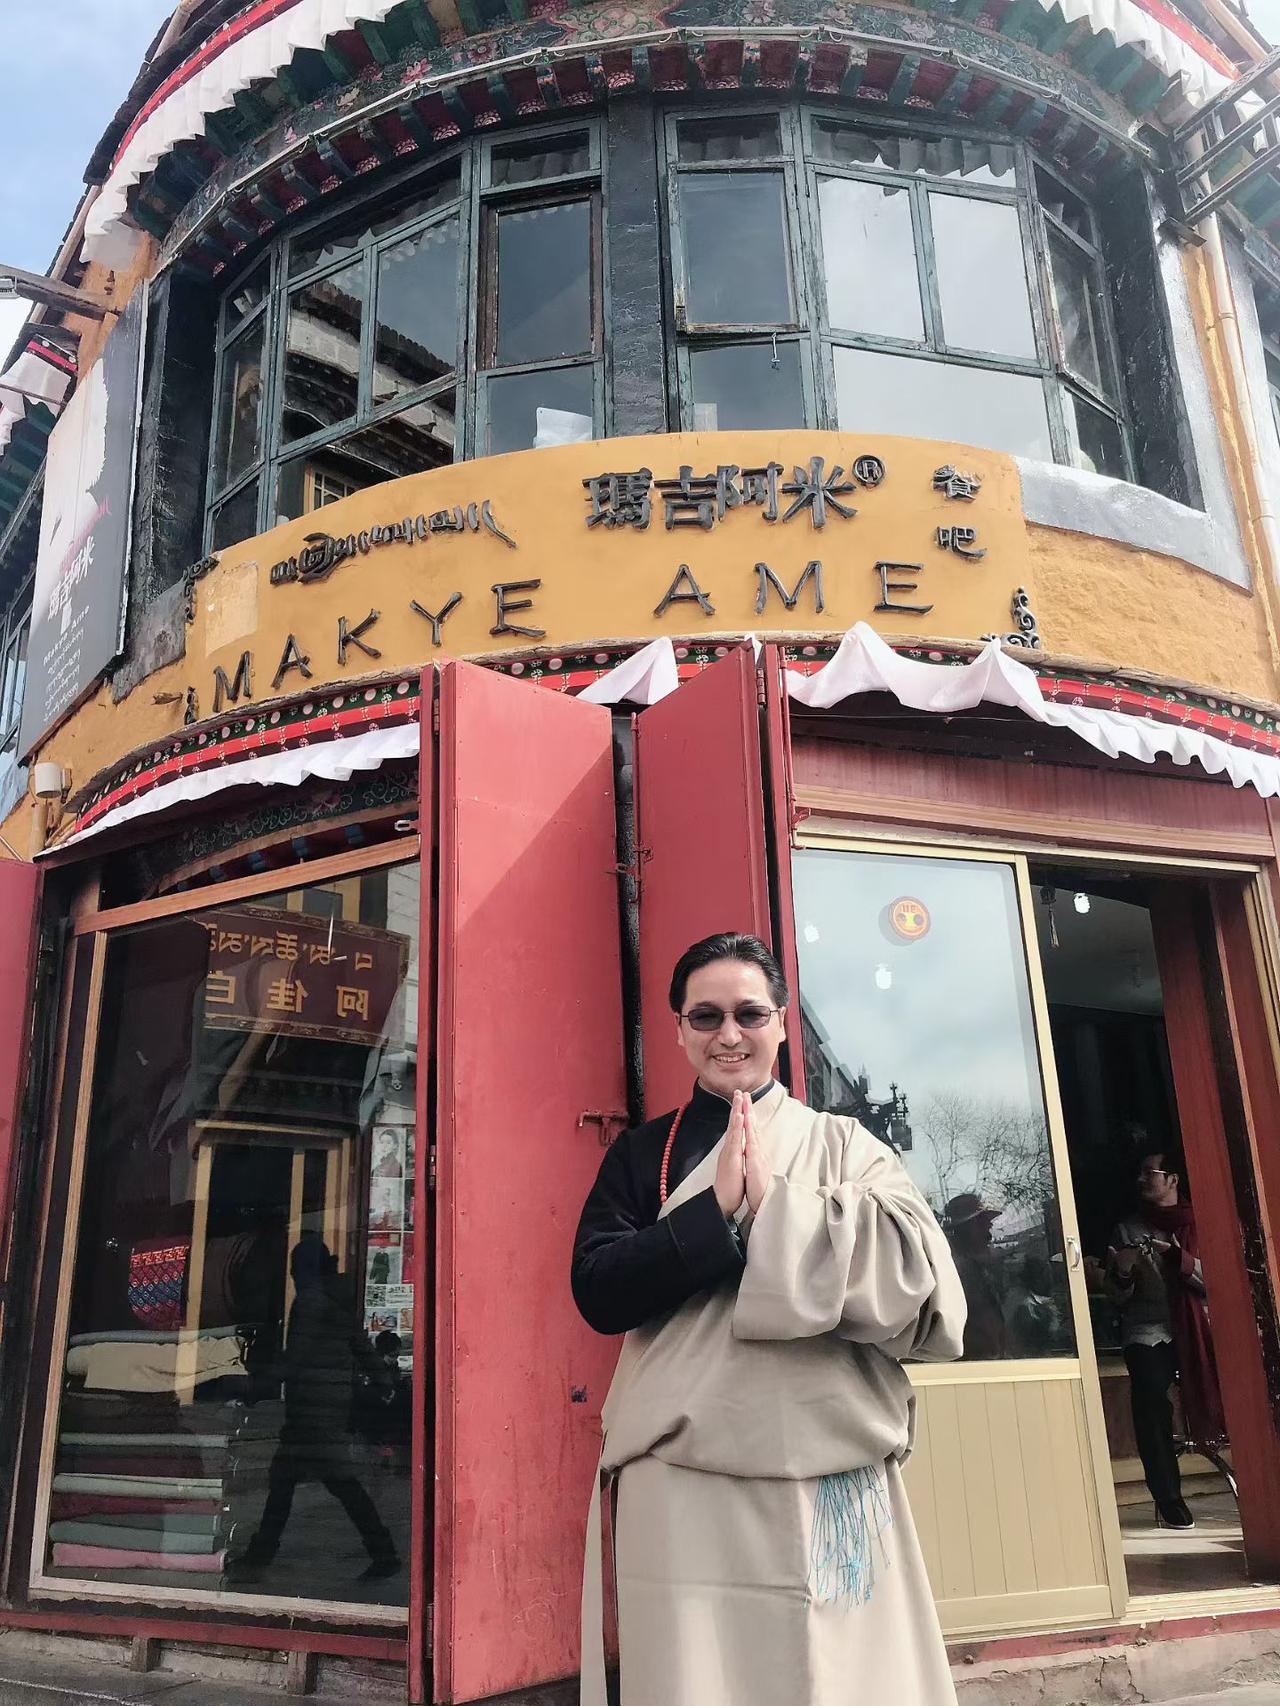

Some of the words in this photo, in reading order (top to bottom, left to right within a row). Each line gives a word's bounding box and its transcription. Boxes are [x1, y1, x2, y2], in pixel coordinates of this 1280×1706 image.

[581, 455, 858, 532] 瑪吉阿米
[212, 578, 547, 713] MAKYE
[653, 559, 934, 618] AME
